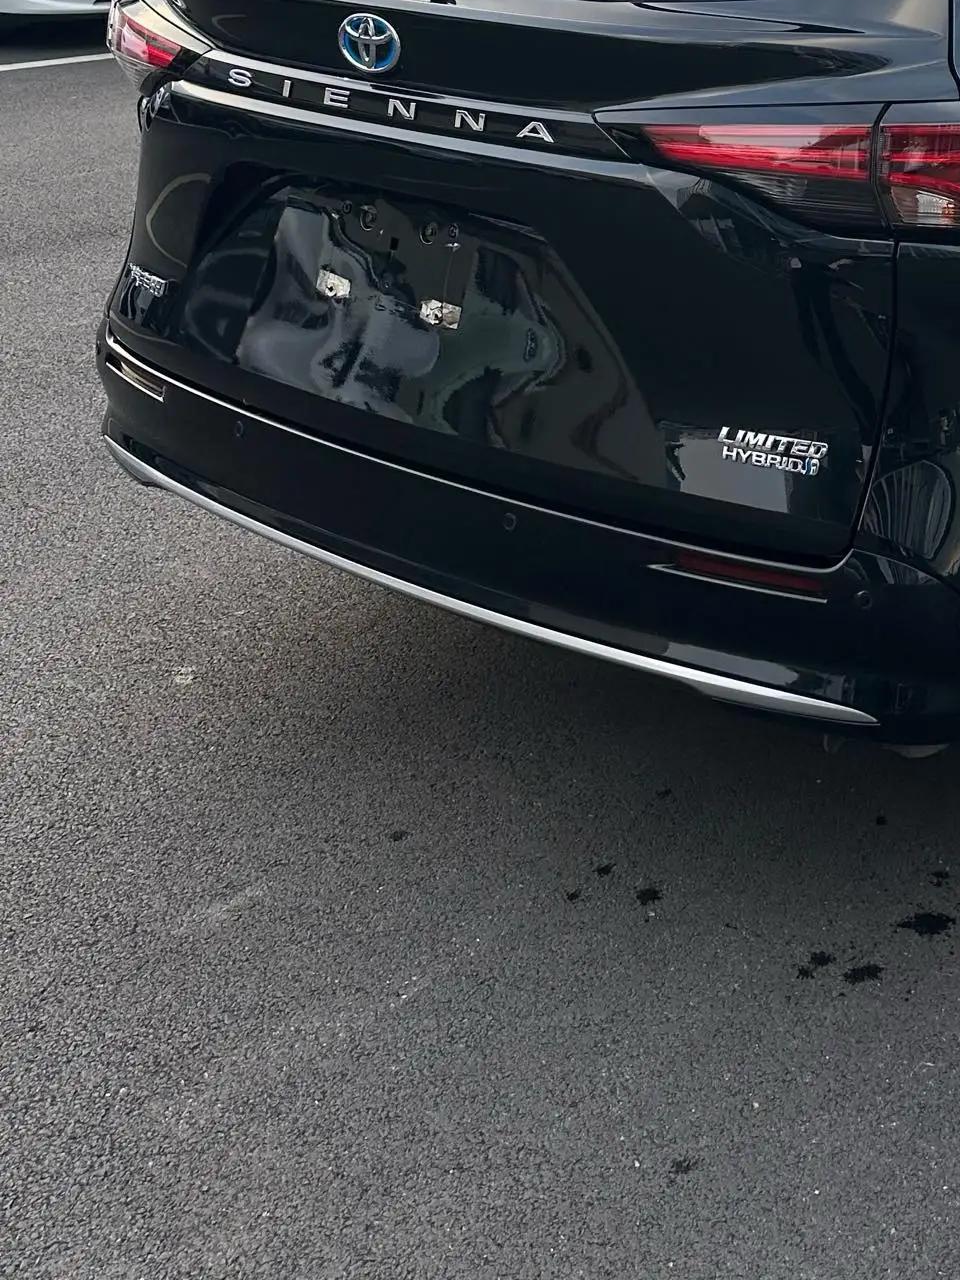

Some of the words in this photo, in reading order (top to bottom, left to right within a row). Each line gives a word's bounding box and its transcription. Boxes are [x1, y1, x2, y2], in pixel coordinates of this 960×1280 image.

[227, 68, 556, 144] SIENNA
[718, 426, 828, 459] LIMITED
[722, 446, 804, 473] HYBRID
